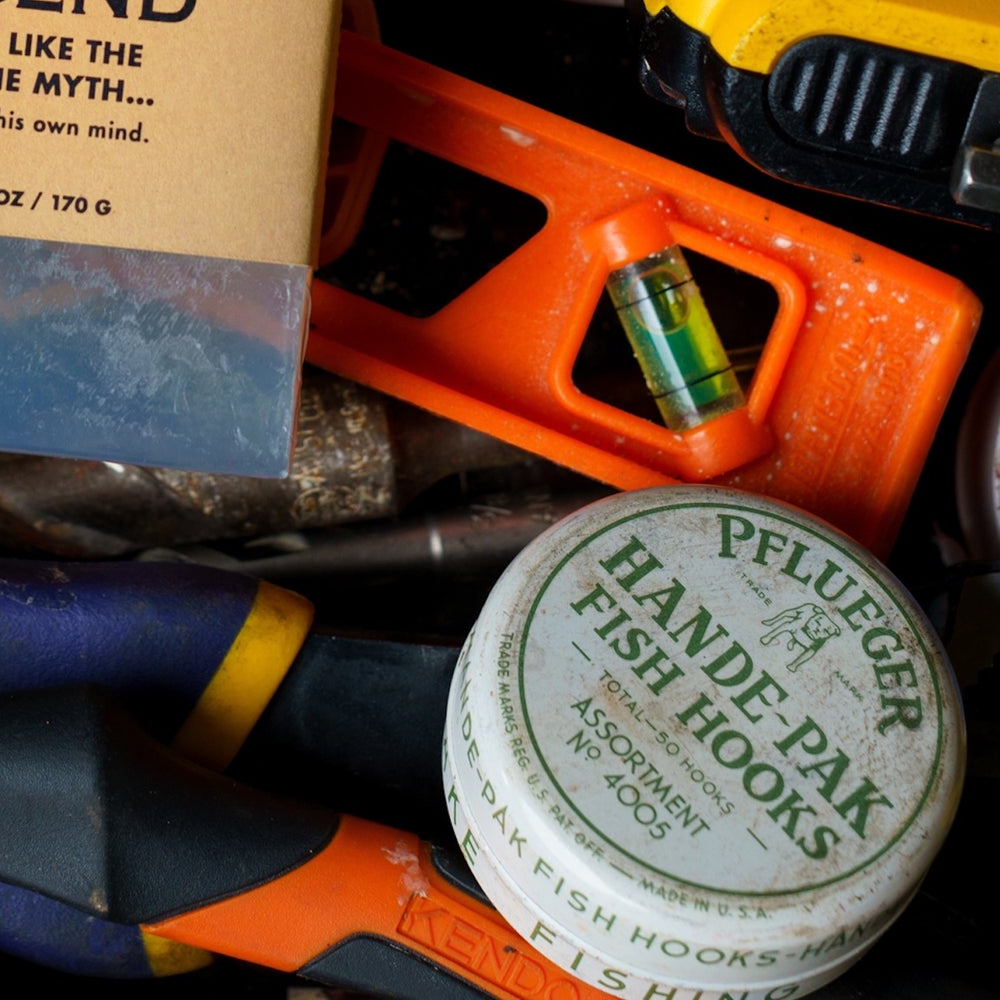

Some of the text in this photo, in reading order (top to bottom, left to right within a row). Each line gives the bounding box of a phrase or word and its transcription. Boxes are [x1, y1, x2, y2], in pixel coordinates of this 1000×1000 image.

[8, 32, 74, 60] LIKE
[86, 40, 144, 67] THE
[33, 72, 154, 107] MYTH...
[33, 117, 79, 136] own
[87, 119, 150, 144] mind.
[30, 191, 43, 210] /
[52, 193, 89, 213] 170
[94, 198, 112, 216] G
[740, 573, 773, 607] TRADE
[717, 514, 923, 736] PFLUEGER
[497, 632, 514, 677] TRADE
[498, 682, 519, 734] MARKS
[598, 535, 894, 841] HANDE-PAK
[570, 582, 841, 860] FISH HOOKS
[570, 697, 711, 837] ASSORTMENT
[679, 757, 735, 815] HOOKS
[603, 774, 672, 840] 4005
[533, 857, 617, 932] FISH
[638, 877, 688, 906] MADE
[694, 896, 710, 913] IN
